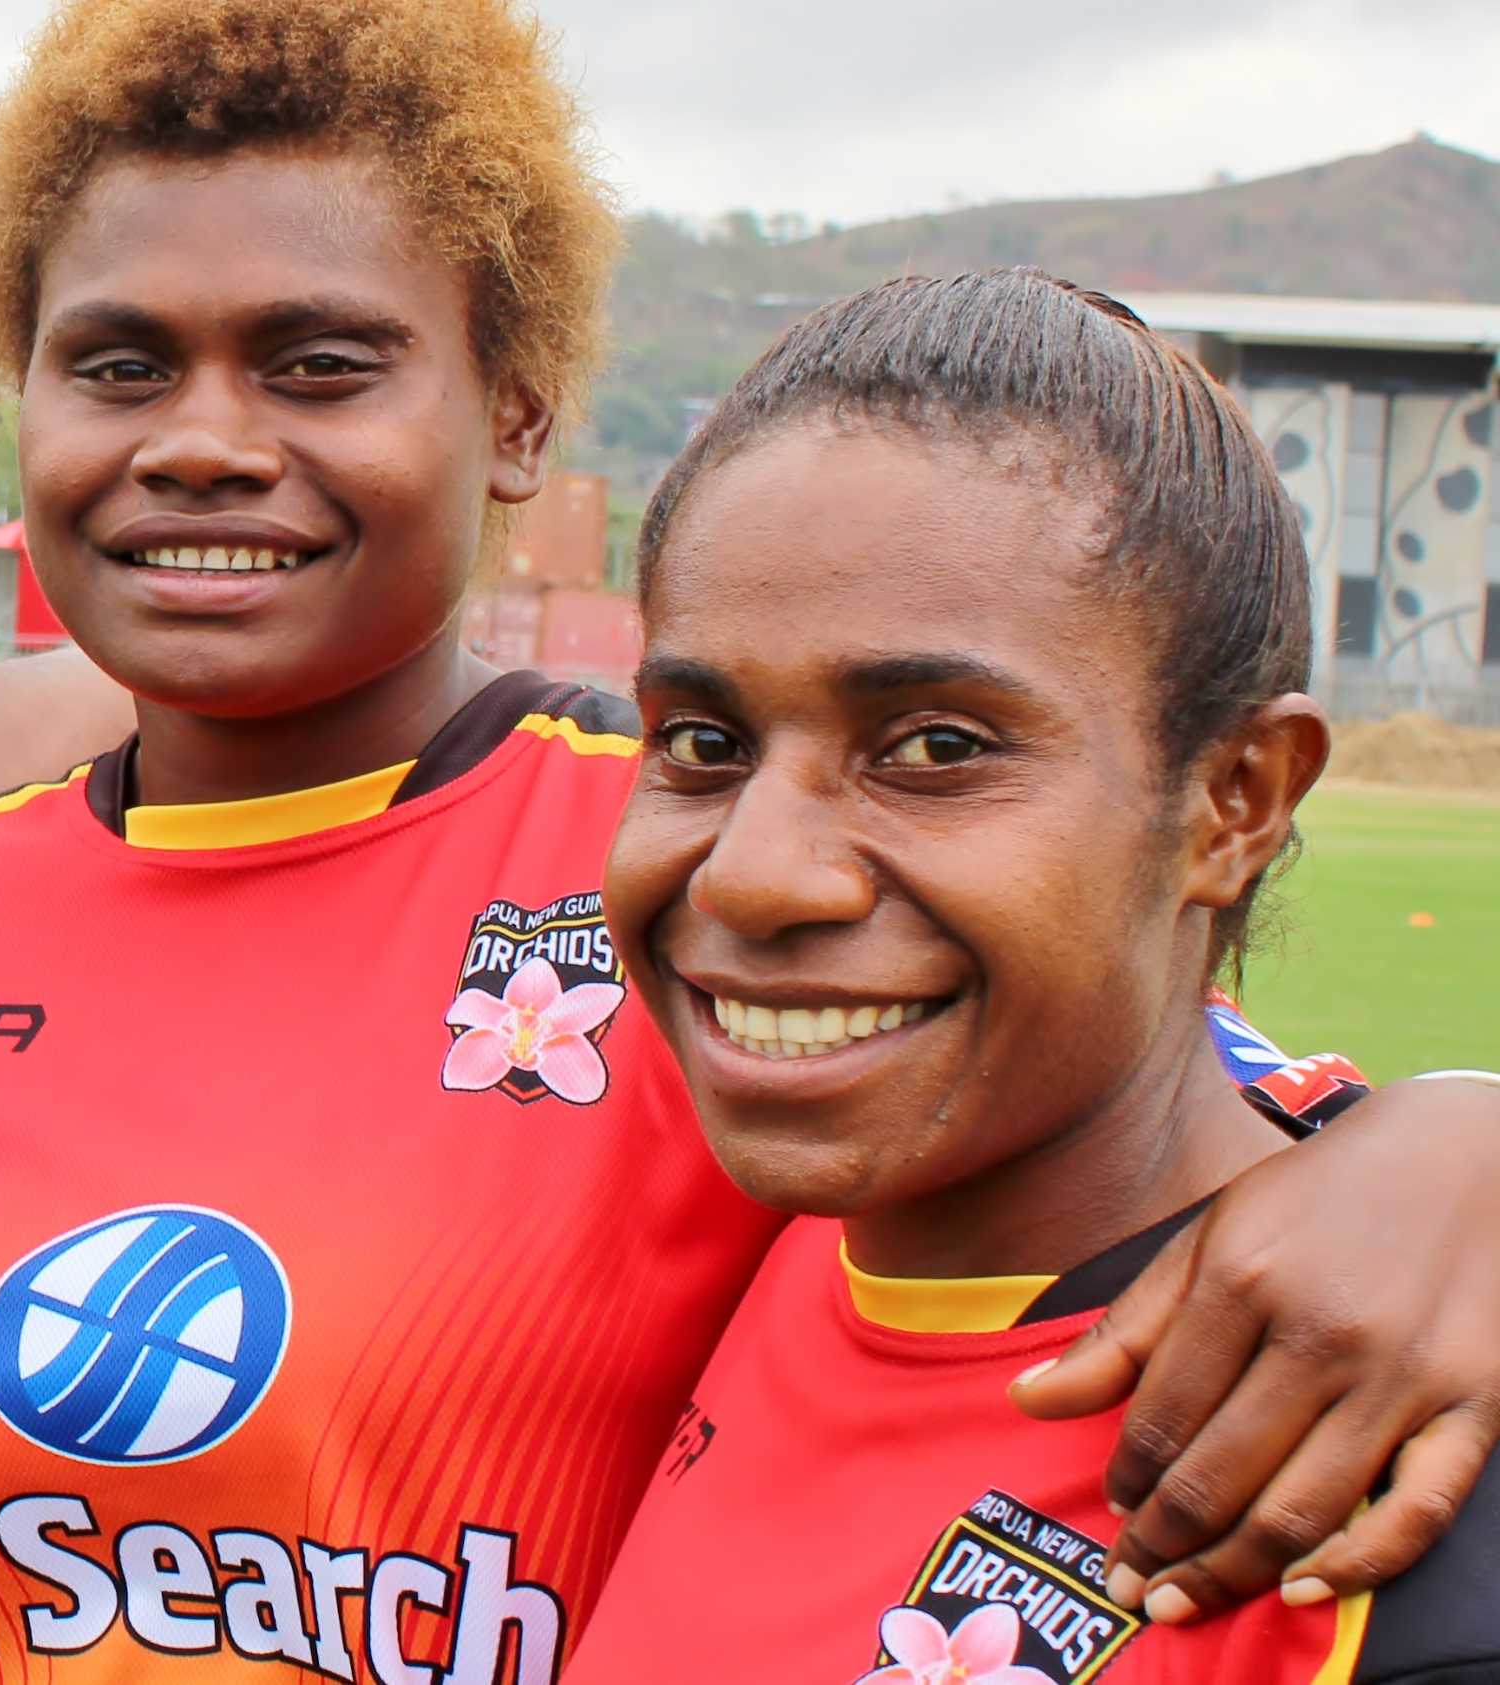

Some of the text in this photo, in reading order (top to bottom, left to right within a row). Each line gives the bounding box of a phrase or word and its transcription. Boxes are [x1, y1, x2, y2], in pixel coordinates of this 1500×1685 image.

[524, 900, 563, 931] NEW
[564, 893, 604, 916] GUIN
[464, 926, 614, 978] ORCHIDS
[1030, 1523, 1089, 1564] NEW
[930, 1539, 1114, 1674] ORCHIDS
